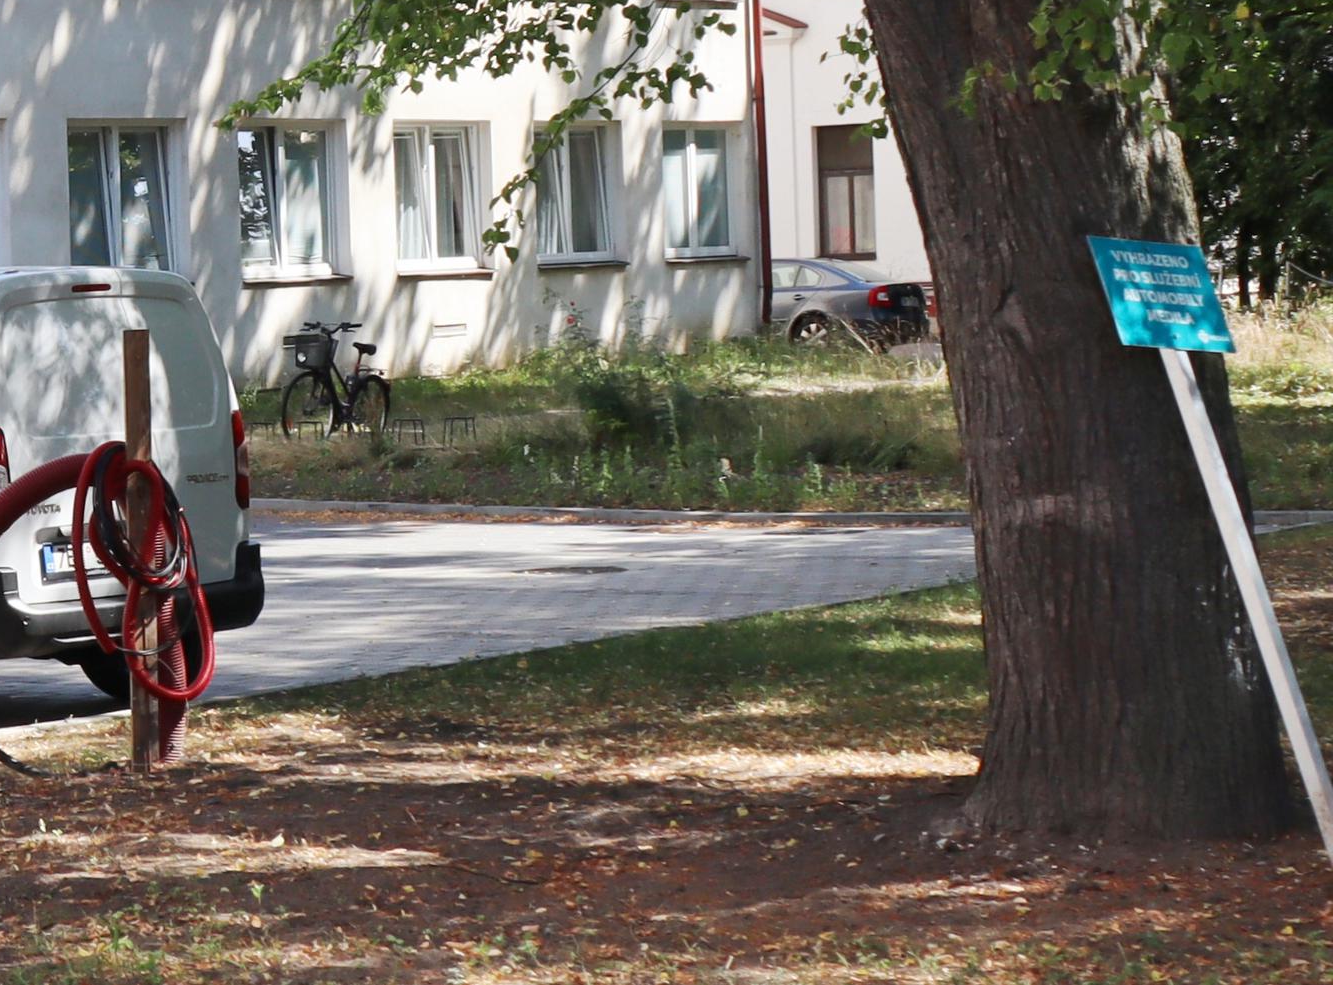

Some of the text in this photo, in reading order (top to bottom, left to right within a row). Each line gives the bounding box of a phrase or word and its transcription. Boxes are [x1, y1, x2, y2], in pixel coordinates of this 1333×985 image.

[1111, 250, 1189, 268] VYHRAZENO
[1113, 268, 1141, 283] PRO
[1124, 288, 1204, 307] AUTOMOBILY
